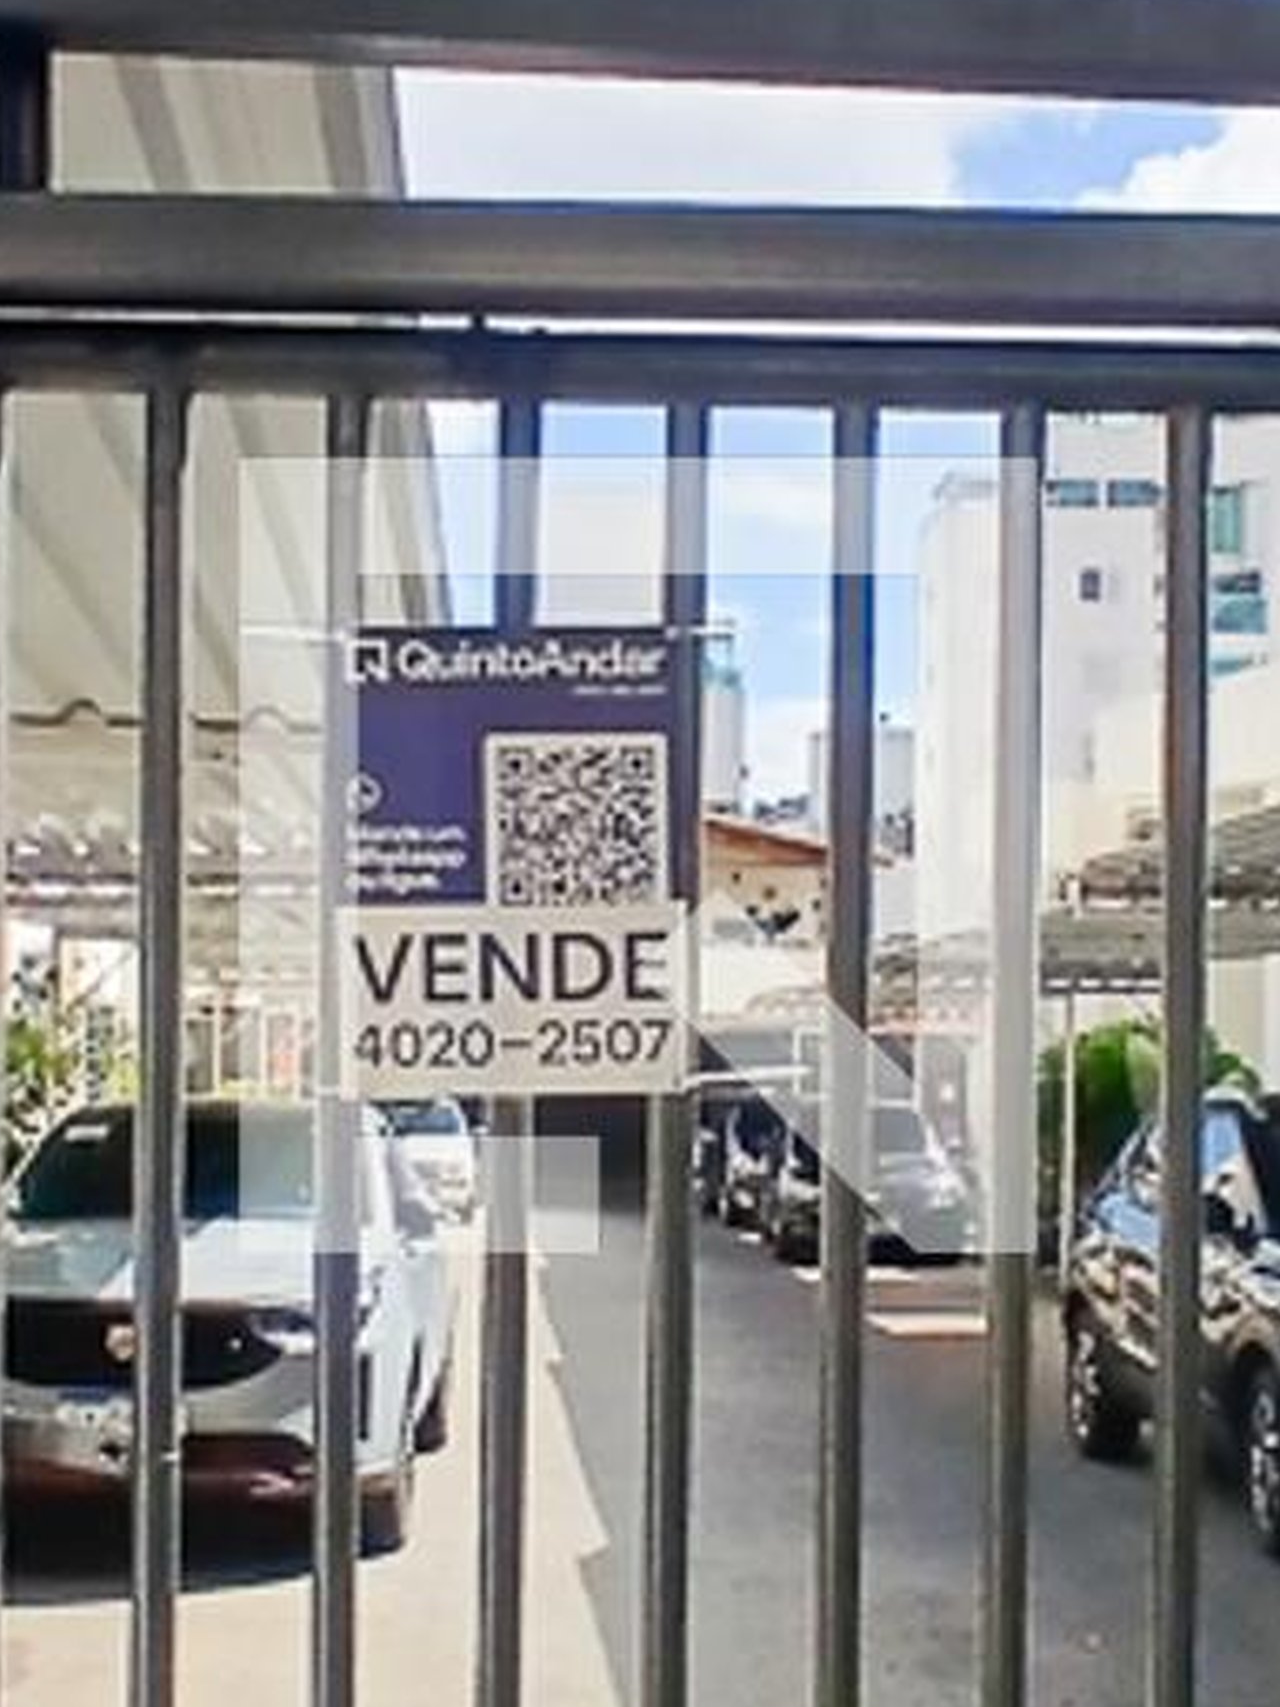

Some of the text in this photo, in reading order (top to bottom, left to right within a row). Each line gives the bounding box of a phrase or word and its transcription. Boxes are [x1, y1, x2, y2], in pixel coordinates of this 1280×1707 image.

[396, 639, 666, 681] QuintoAndar
[353, 931, 670, 1003] VENDE
[353, 1017, 671, 1070] 4020-2507
